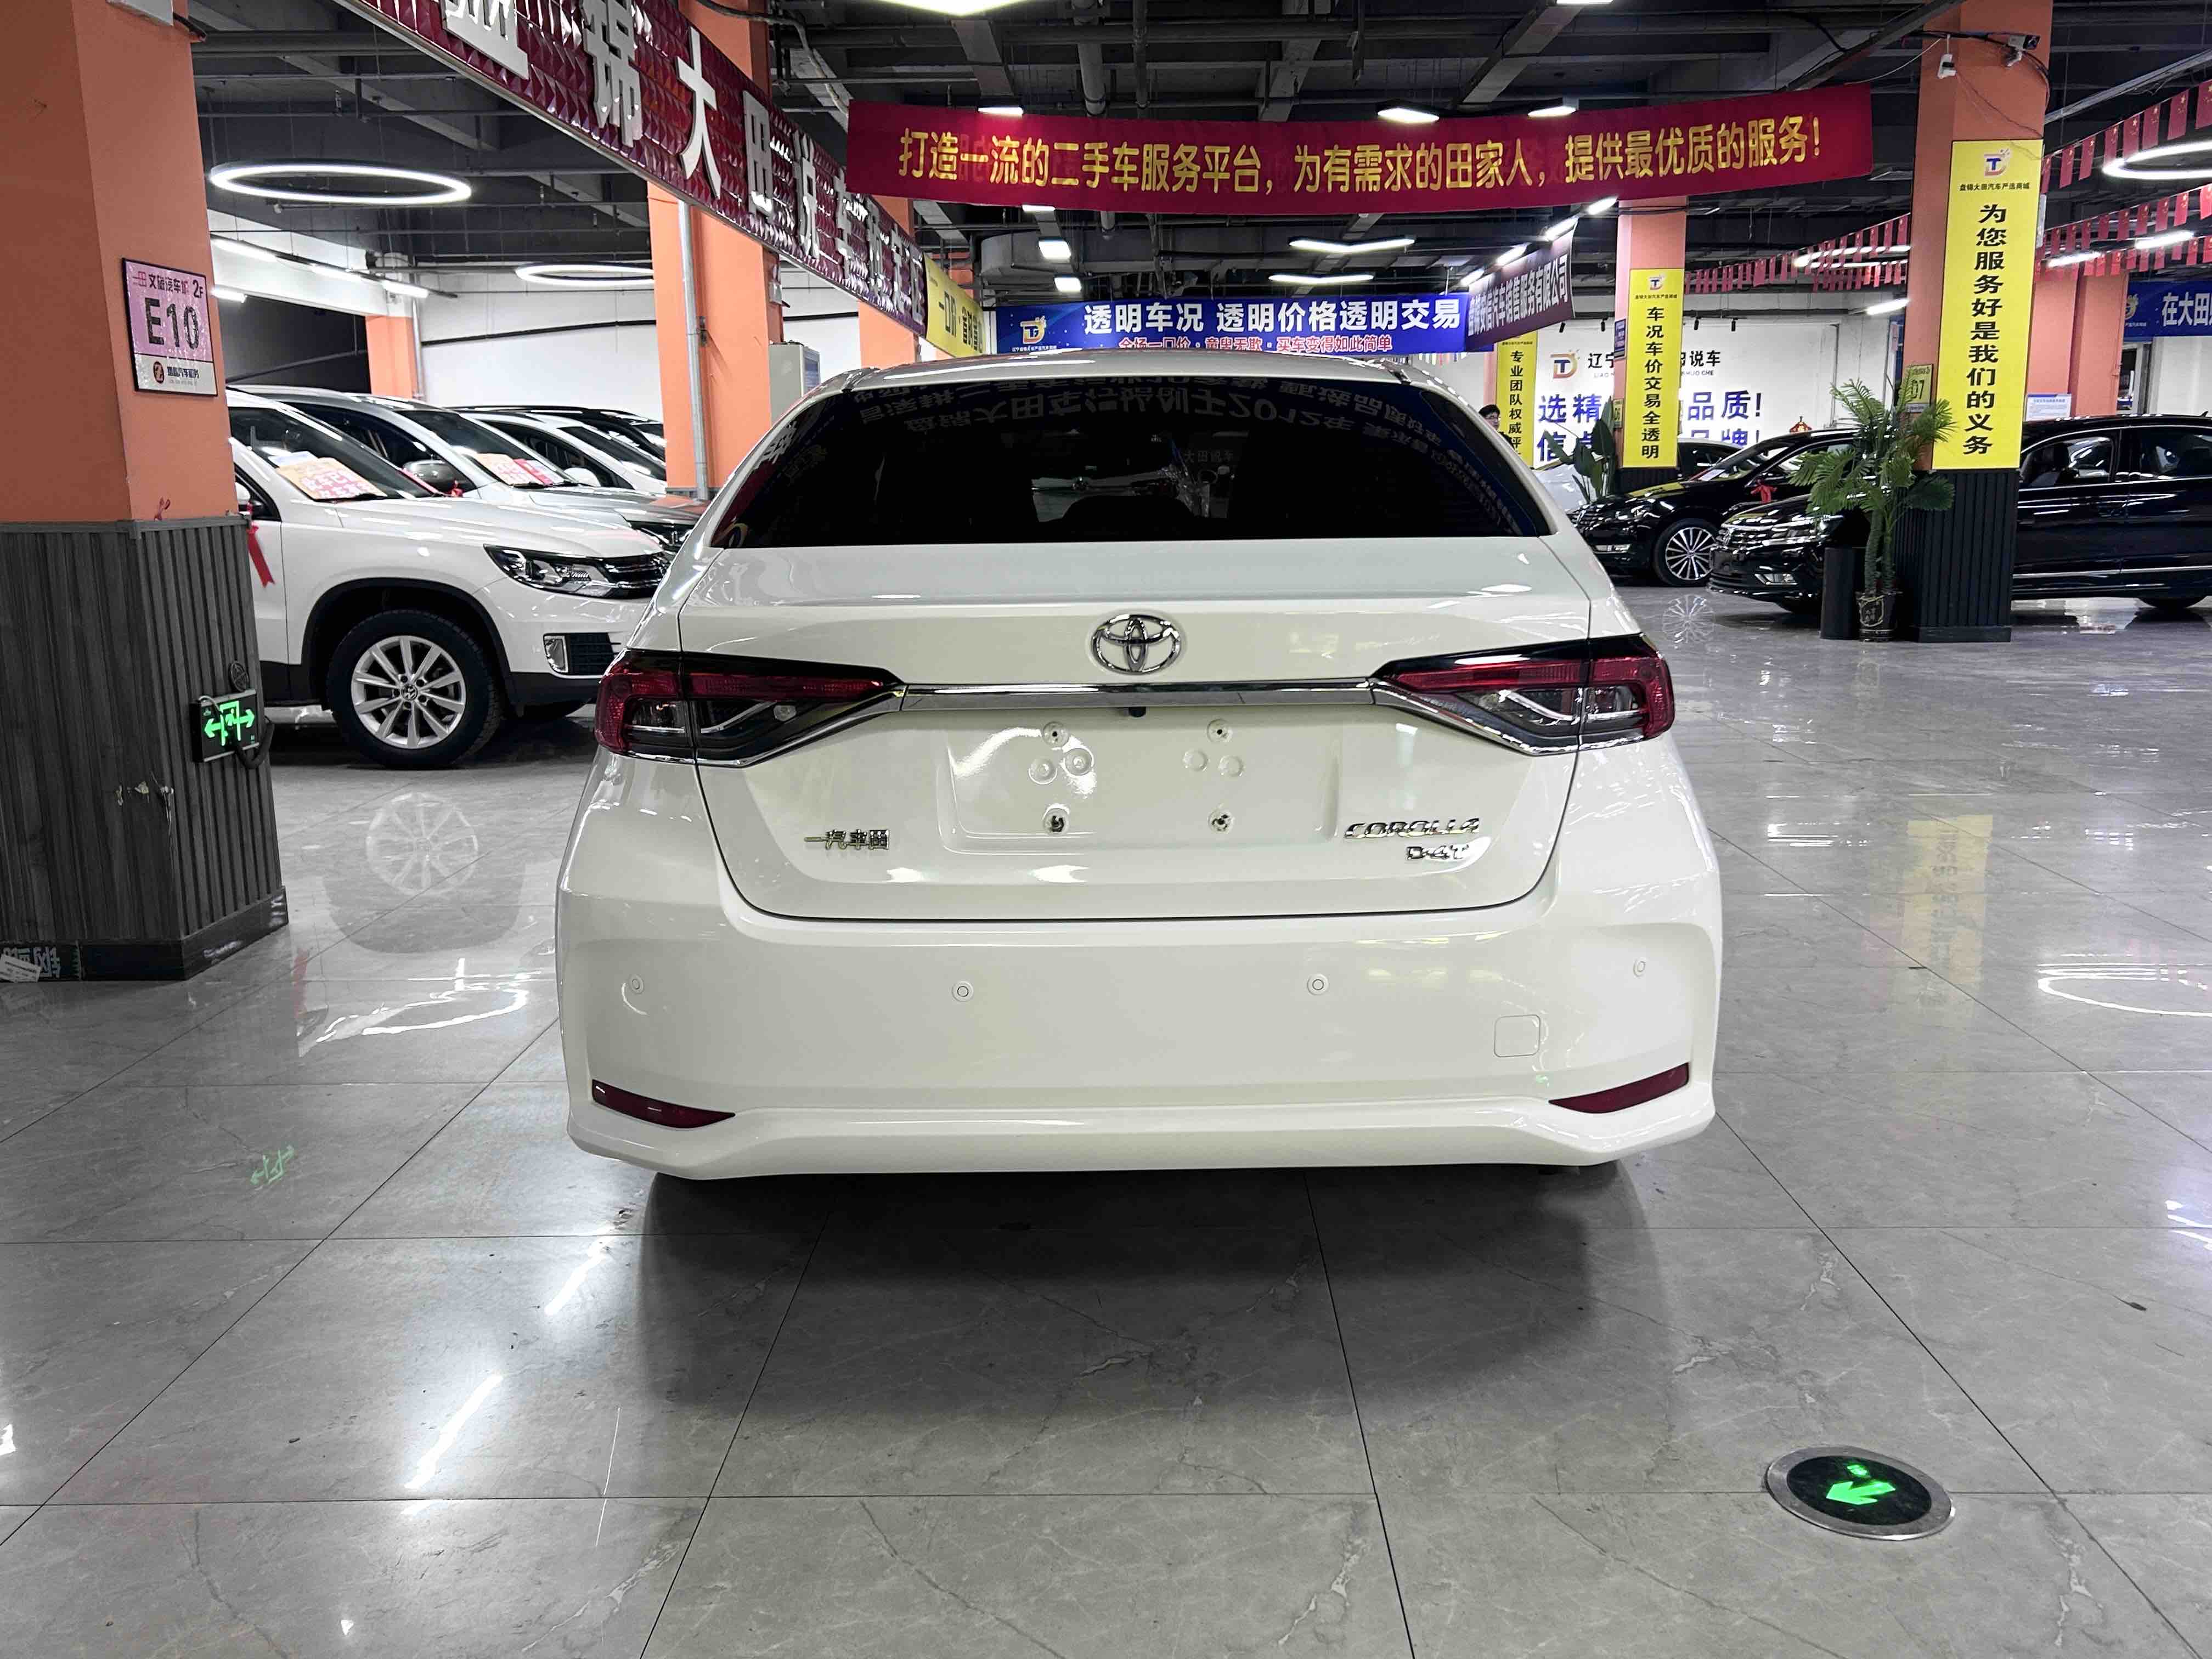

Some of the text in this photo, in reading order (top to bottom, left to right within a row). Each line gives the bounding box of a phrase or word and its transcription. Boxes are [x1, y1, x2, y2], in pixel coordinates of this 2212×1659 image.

[144, 297, 199, 349] E10
[1084, 298, 1460, 335] 透明车况 透明价格透明交易
[1962, 204, 2007, 455] 为您服务好是我们的义务
[2162, 291, 2212, 326] 在大田
[1509, 351, 1524, 455] 专业团队权威评
[1641, 307, 1665, 459] 车况车价交易全透明
